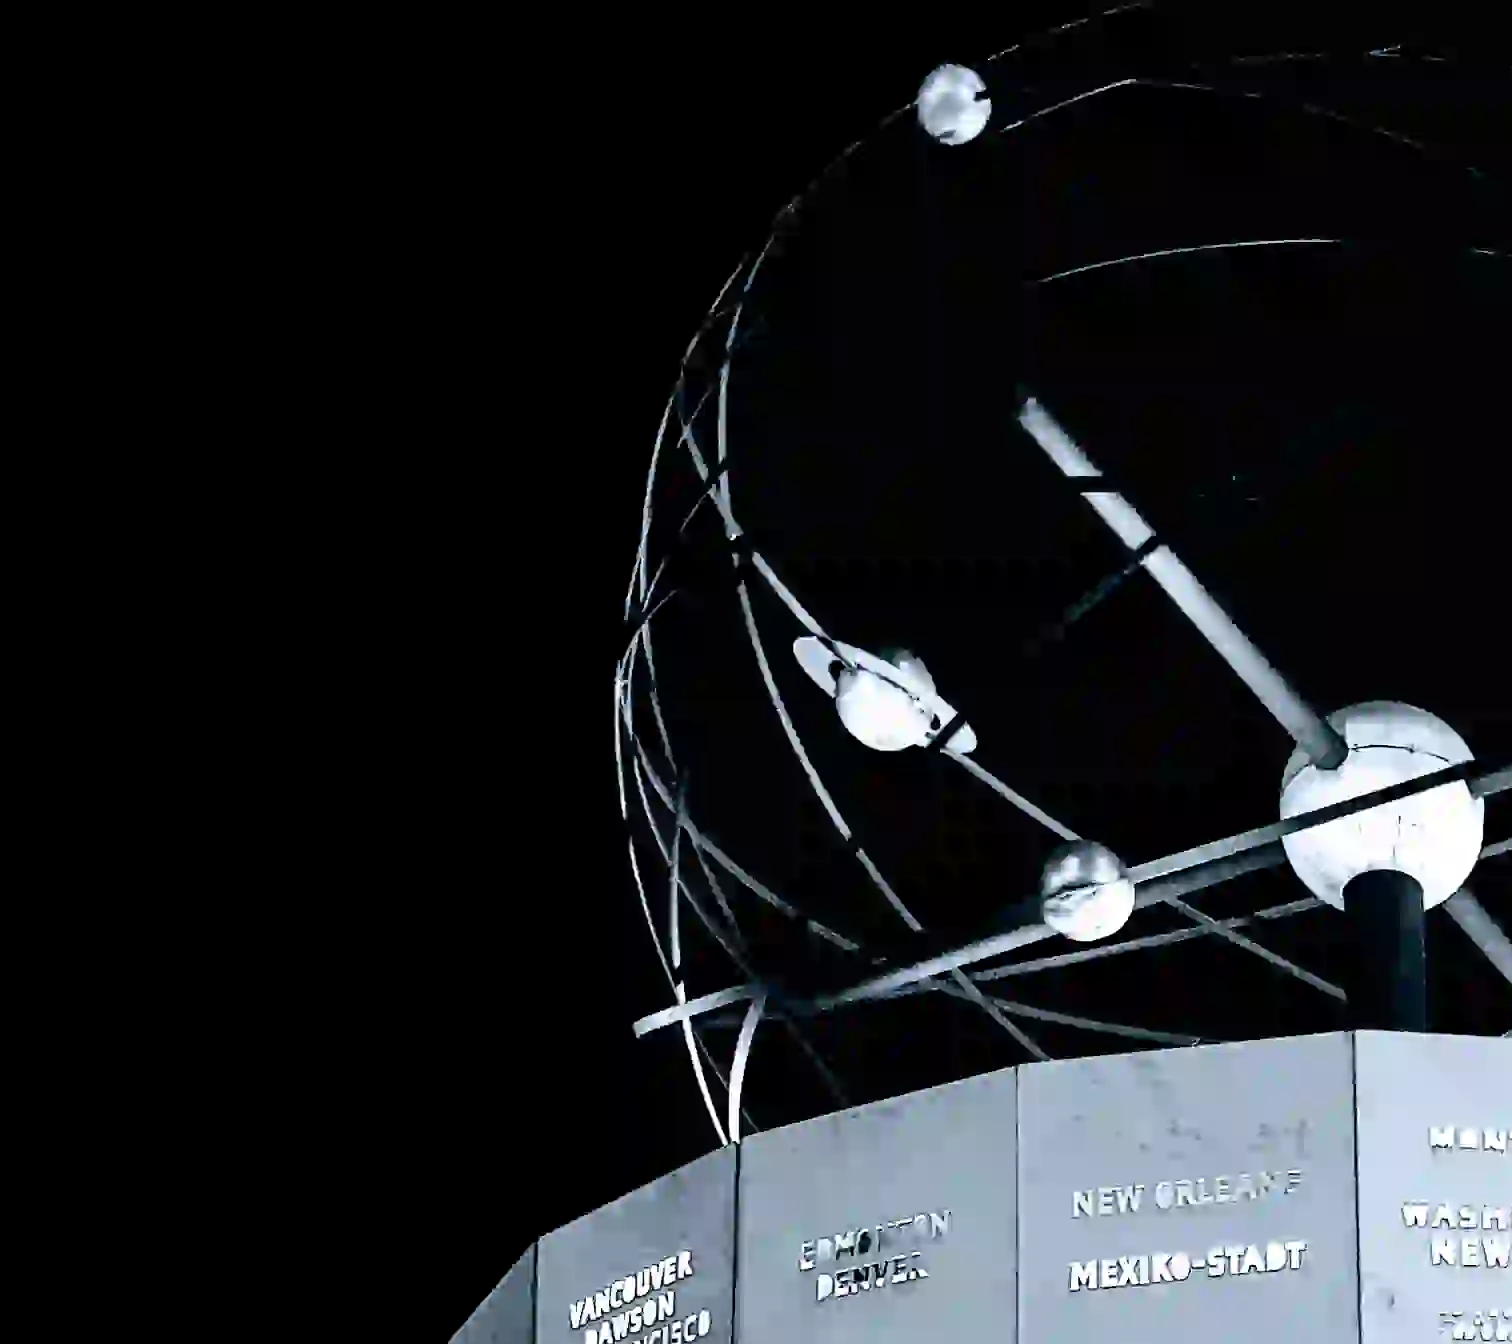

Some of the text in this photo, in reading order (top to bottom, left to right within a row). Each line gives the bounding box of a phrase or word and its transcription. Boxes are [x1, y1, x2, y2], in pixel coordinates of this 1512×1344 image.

[1071, 1183, 1146, 1219] NEW
[1067, 1239, 1309, 1293] MEXIKO-STADT
[1429, 1234, 1512, 1270] NEW
[568, 1250, 693, 1329] VANCOUVER
